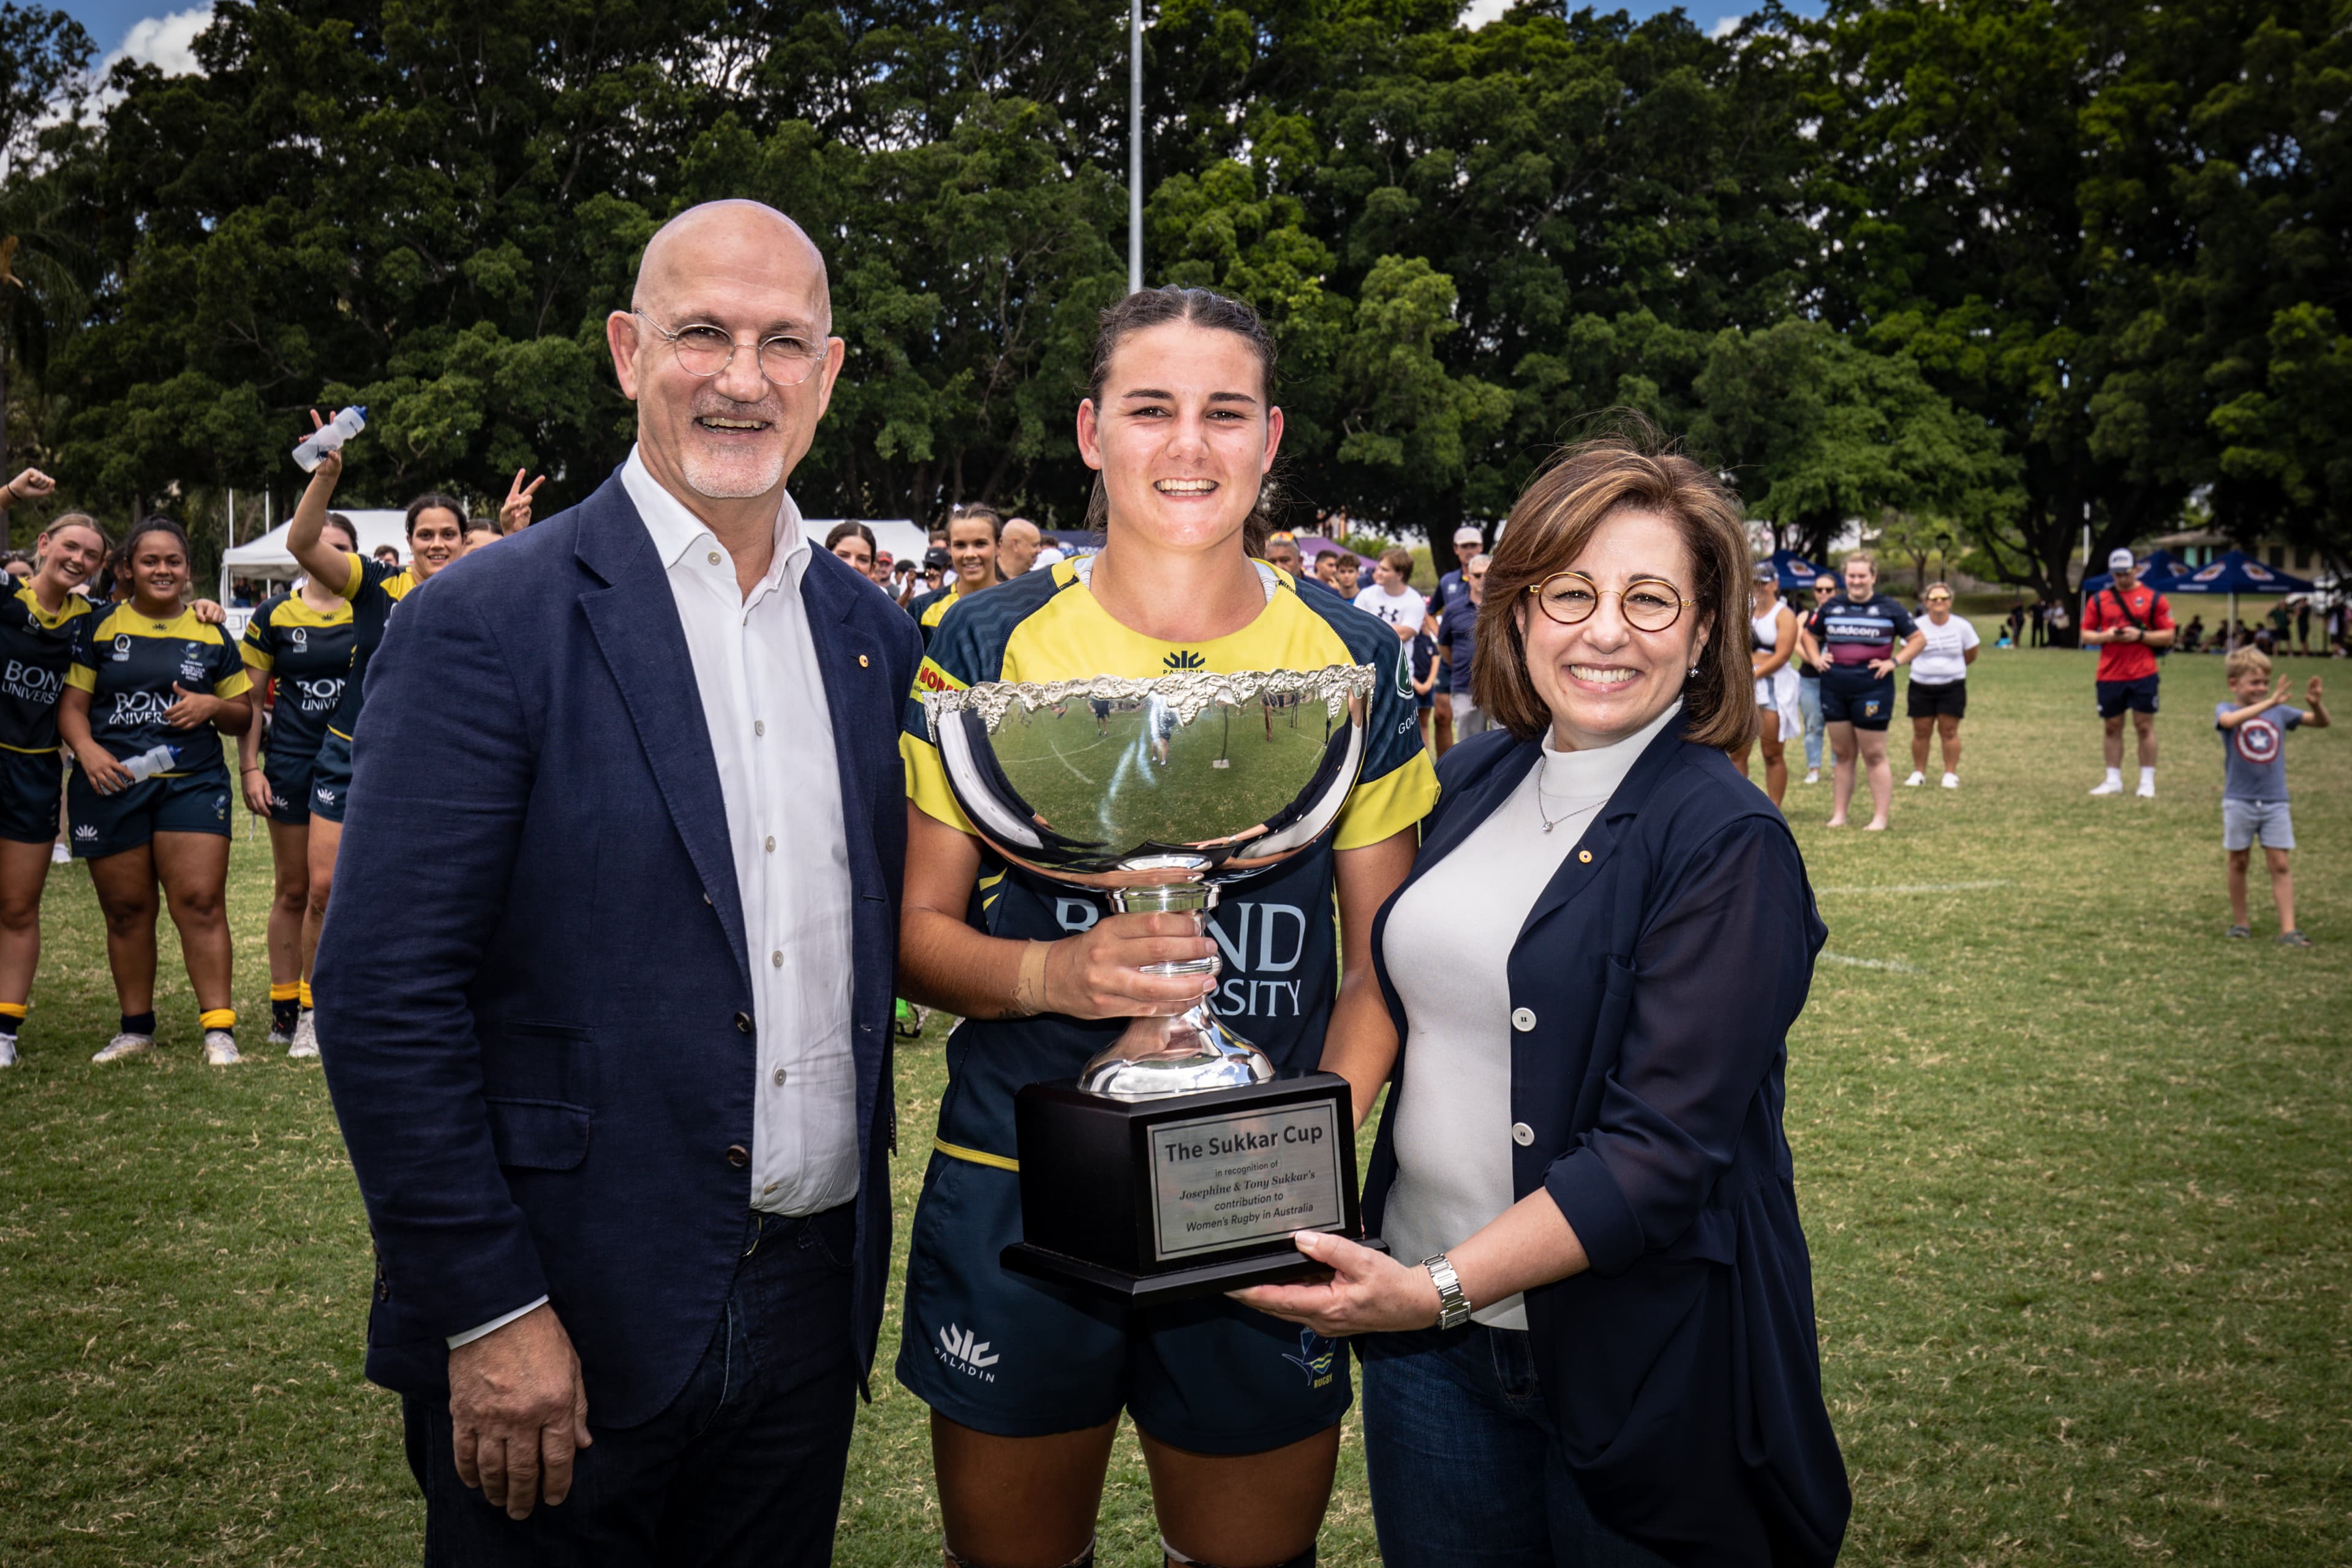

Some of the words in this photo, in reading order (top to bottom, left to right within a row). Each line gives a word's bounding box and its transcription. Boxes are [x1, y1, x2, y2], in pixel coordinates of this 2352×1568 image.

[1165, 1143, 1203, 1162] The
[1208, 1132, 1278, 1156] Sukkar
[1283, 1125, 1323, 1144] Cup
[1215, 1169, 1223, 1177] in
[1224, 1163, 1268, 1175] recognition
[1270, 1159, 1279, 1169] of
[1180, 1184, 1231, 1200] Josephine
[1234, 1182, 1242, 1192] &
[1244, 1178, 1270, 1190] Tony
[1272, 1169, 1316, 1186] Sukkar's
[1215, 1194, 1272, 1211] contribution
[1275, 1192, 1284, 1201] to
[1186, 1216, 1229, 1232] Women's
[1231, 1212, 1260, 1225] Rugby
[1262, 1210, 1271, 1219] in
[1273, 1203, 1314, 1218] Australia
[934, 1346, 995, 1384] PALADIN
[1314, 1373, 1333, 1389] RUGBY
